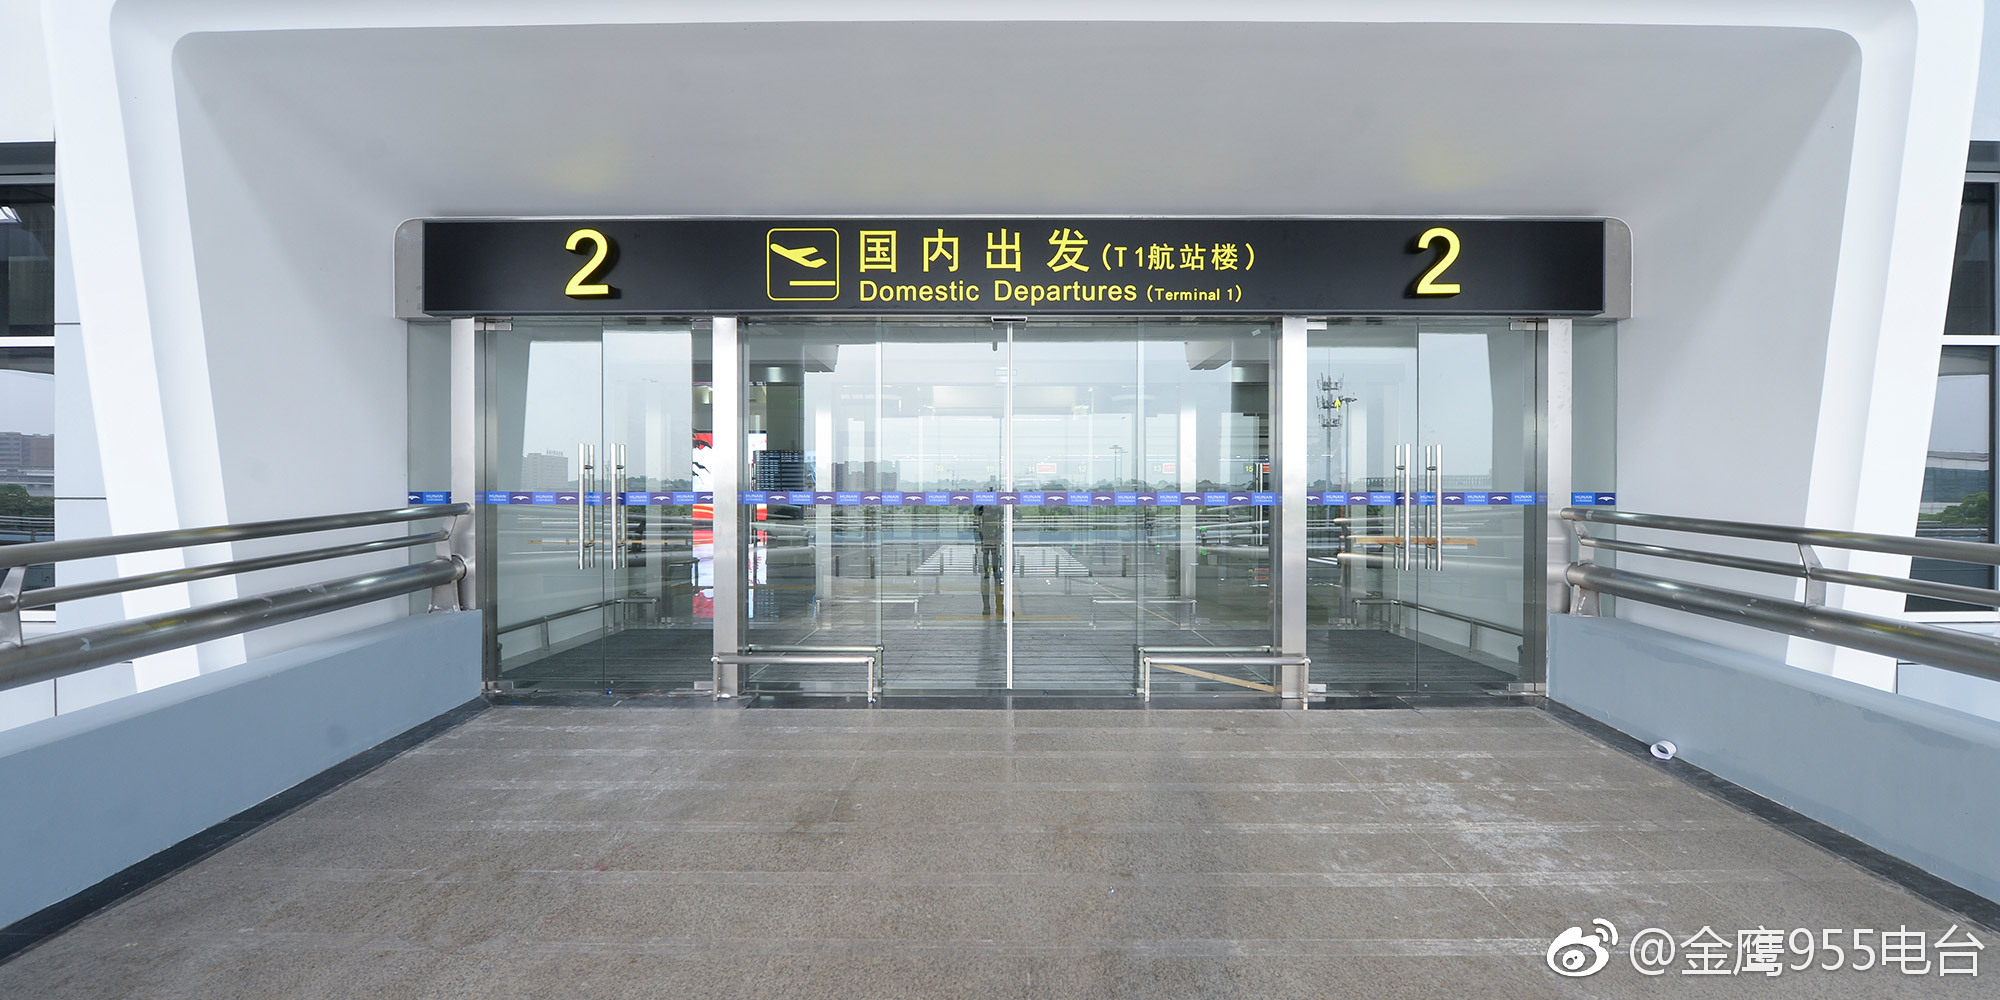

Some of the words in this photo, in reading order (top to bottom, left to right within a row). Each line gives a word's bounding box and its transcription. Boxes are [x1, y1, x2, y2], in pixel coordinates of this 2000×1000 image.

[564, 228, 609, 296] 2
[859, 227, 1090, 273] 国内出发
[1416, 227, 1461, 295] 2
[859, 280, 980, 302] Domestic
[994, 279, 1137, 306] Departures
[1146, 285, 1220, 303] (Terminal
[1227, 285, 1242, 303] 1)
